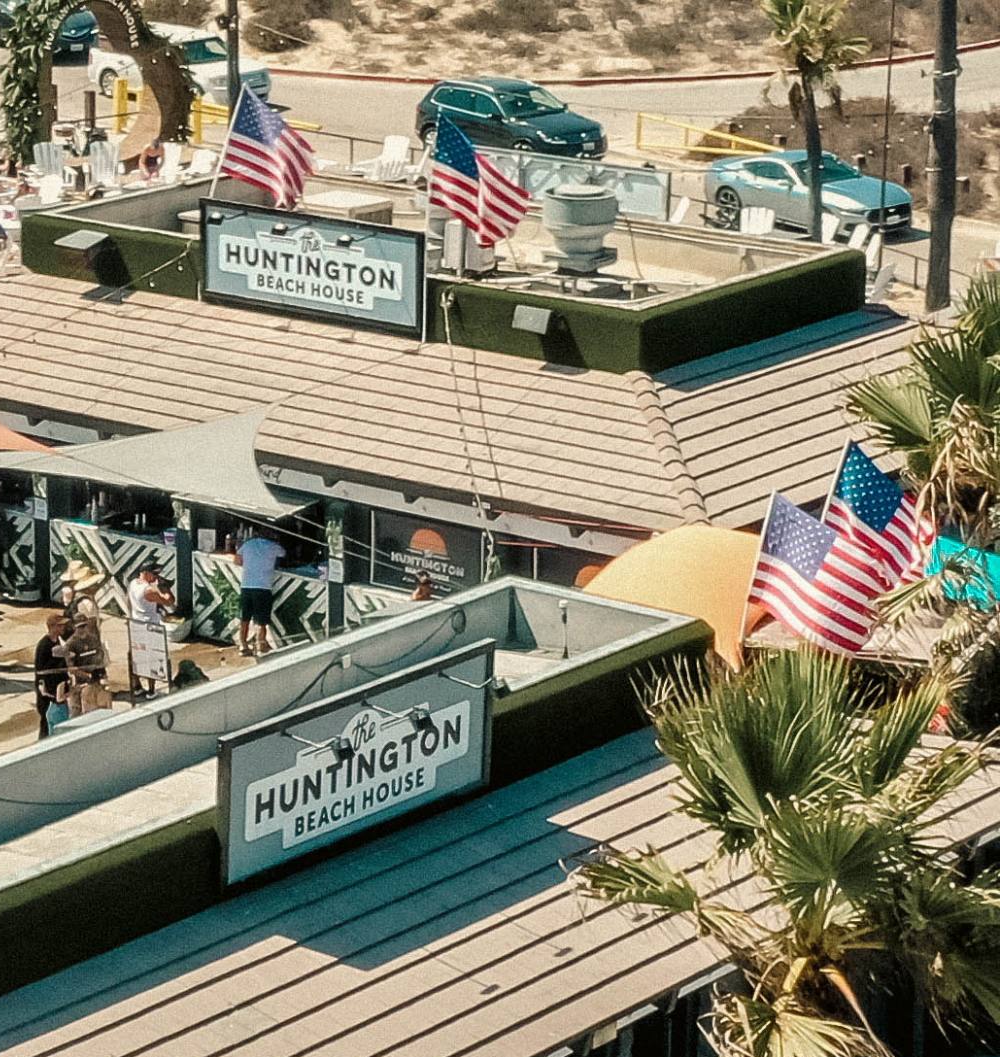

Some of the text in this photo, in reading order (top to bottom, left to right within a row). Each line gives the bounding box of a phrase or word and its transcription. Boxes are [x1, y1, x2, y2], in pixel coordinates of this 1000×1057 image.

[226, 243, 396, 290] HUNTINGTON
[256, 273, 365, 305] BEACH HOUSE
[351, 713, 376, 752] the
[254, 714, 462, 825] HUNTINGTON
[294, 766, 425, 837] BEACH HOUSE
